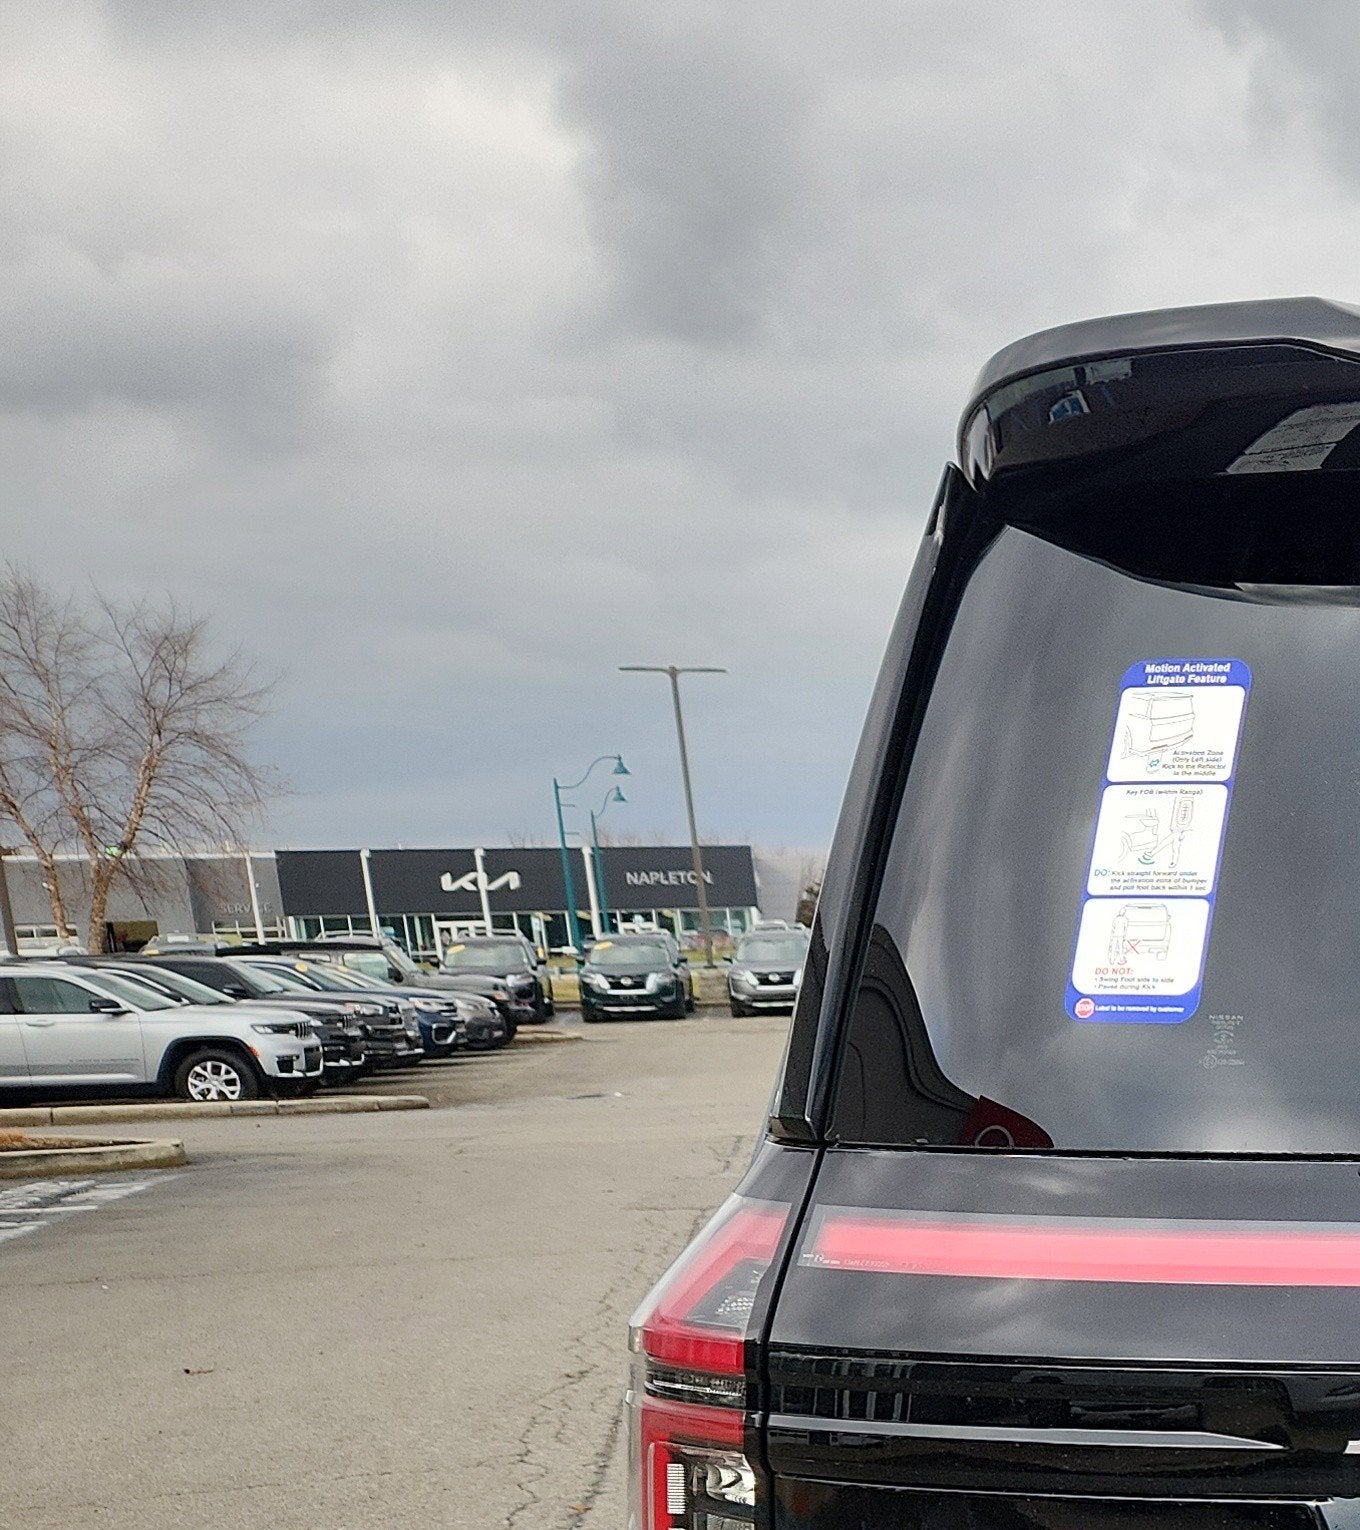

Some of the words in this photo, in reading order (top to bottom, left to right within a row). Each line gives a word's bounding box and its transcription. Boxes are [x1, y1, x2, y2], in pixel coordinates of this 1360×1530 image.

[1145, 662, 1182, 674] Motion
[1183, 662, 1231, 673] Activated
[1147, 674, 1186, 686] Liftgate
[1188, 674, 1227, 684] Feature
[1094, 869, 1110, 877] DO:
